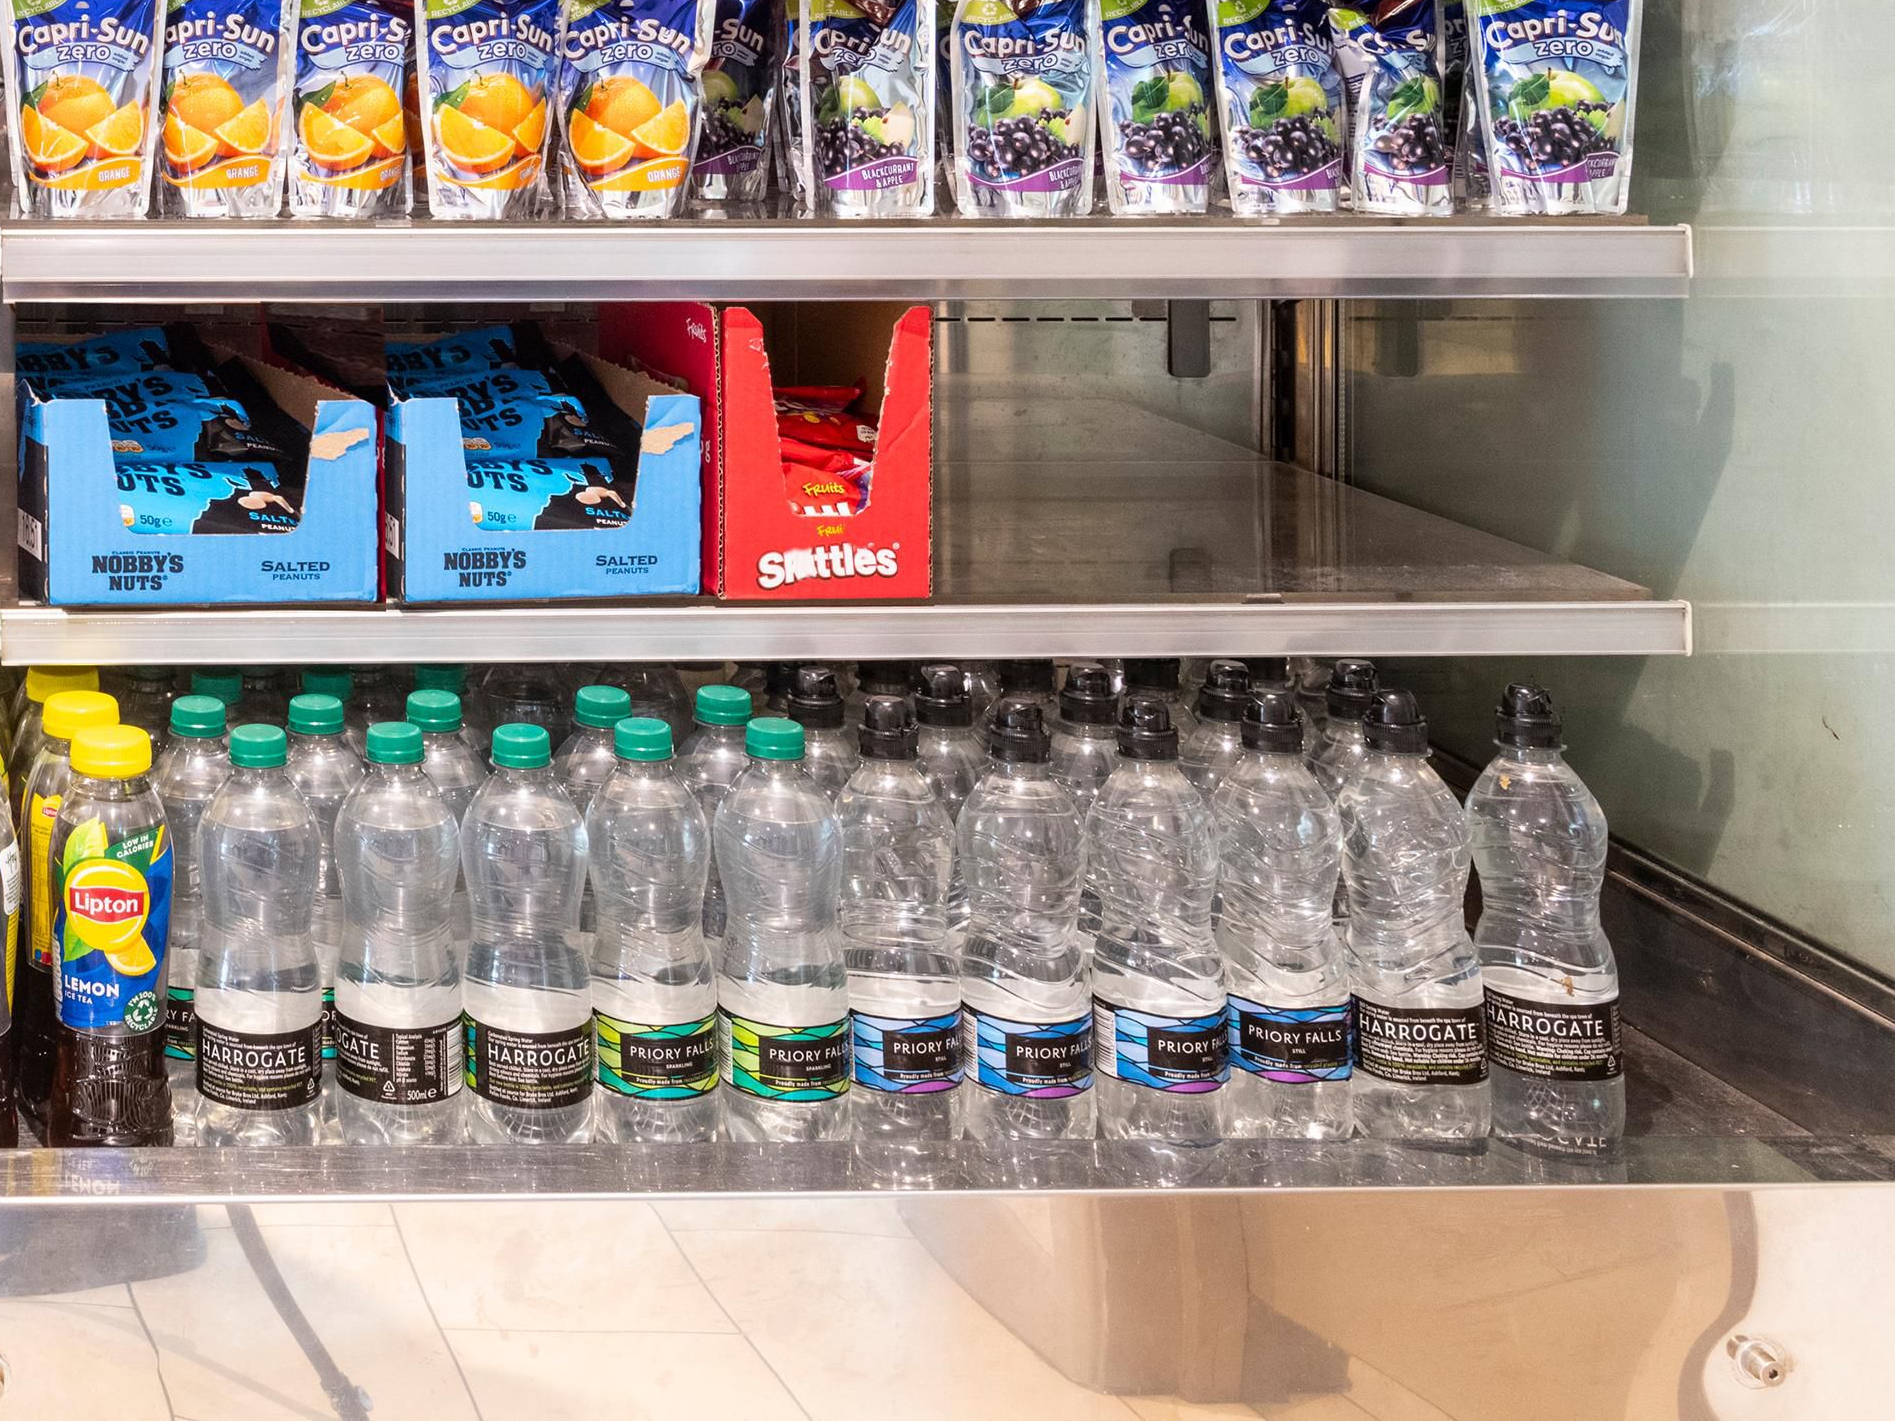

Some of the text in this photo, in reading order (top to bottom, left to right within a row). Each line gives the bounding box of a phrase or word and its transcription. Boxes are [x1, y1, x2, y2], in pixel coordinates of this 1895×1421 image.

[18, 14, 149, 56] Capri-Sun
[57, 42, 111, 61] zero
[98, 167, 130, 182] ORANGE
[861, 162, 915, 181] BLACKCURRANT
[91, 552, 184, 574] NOBBY'S
[260, 560, 330, 572] SALTED
[109, 574, 163, 591] NUTS
[117, 840, 155, 858] CALORIES
[121, 834, 149, 850] LOW IN
[75, 892, 139, 913] Lipton
[65, 974, 119, 998] LEMON
[65, 990, 93, 1004] ICE TEA
[1487, 1003, 1604, 1037] HARROGATE
[1248, 1024, 1342, 1044] PRIORY FALLS
[203, 1038, 305, 1067] HARROGATE
[630, 1039, 714, 1062] PRIORY FALLS
[666, 1062, 693, 1070] SPARKLING
